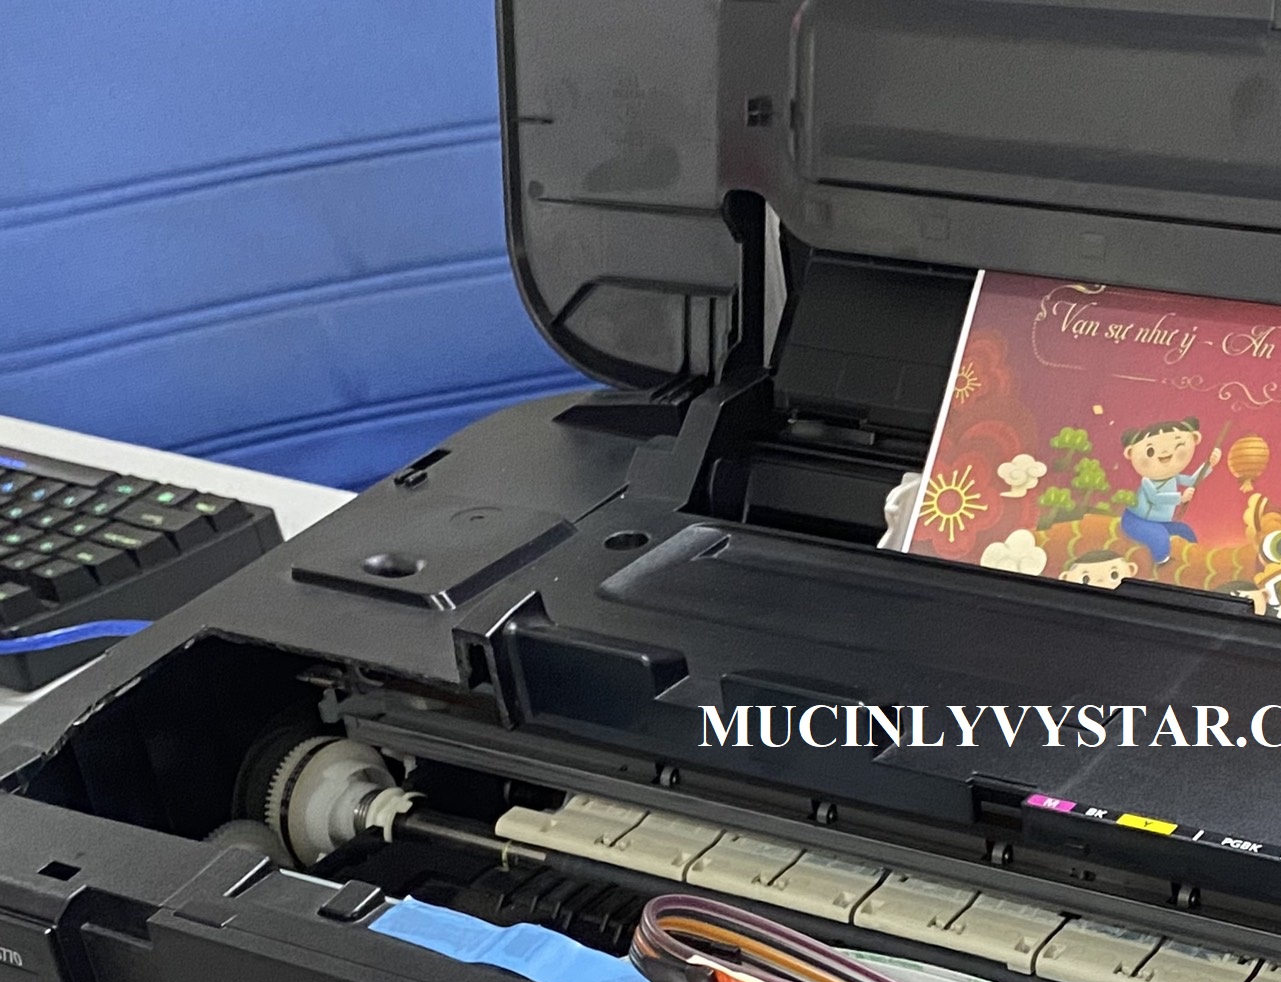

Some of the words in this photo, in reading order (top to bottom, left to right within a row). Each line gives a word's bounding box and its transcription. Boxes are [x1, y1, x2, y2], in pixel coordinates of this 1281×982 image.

[1052, 300, 1100, 339] Vạn
[1105, 323, 1134, 344] sự
[1134, 312, 1179, 346] như
[1164, 326, 1198, 365] ý
[1043, 798, 1060, 809] M
[1085, 807, 1108, 819] BK
[1143, 820, 1154, 828] Y
[1220, 837, 1263, 853] PGBK
[0, 946, 22, 967] 770
